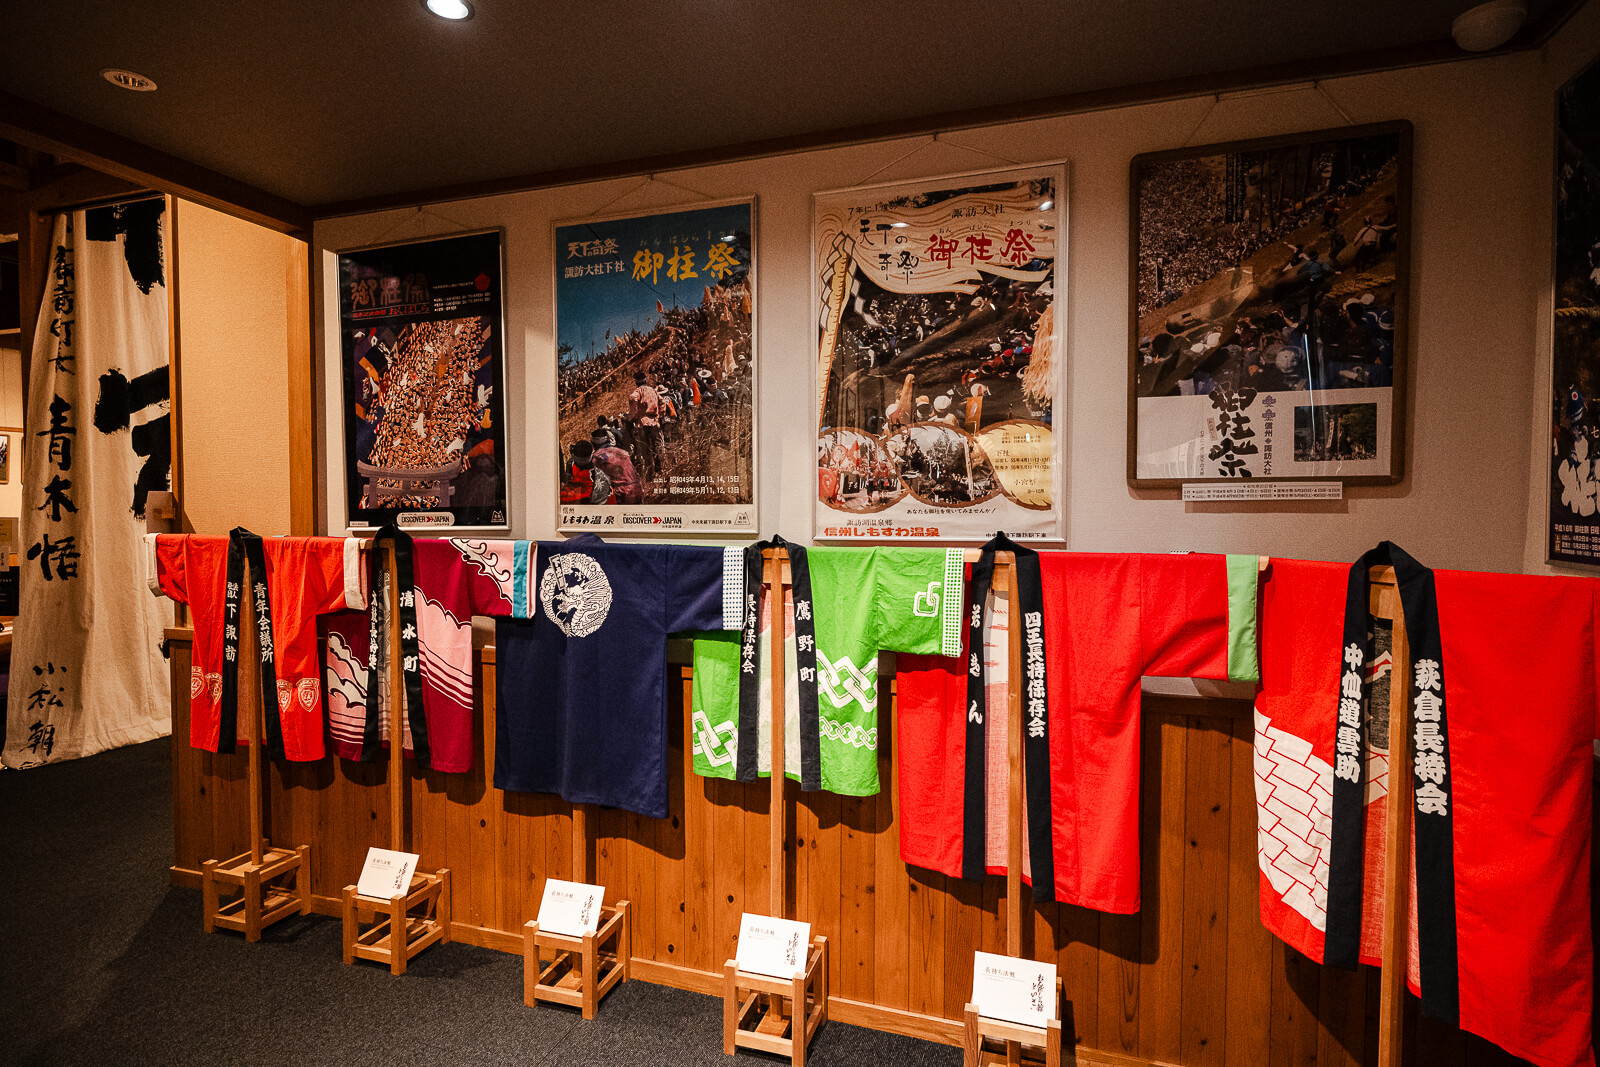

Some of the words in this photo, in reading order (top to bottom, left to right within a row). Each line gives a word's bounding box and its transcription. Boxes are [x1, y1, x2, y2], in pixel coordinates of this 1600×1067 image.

[951, 204, 1006, 219] 諏訪大社
[567, 238, 620, 260] 天下の奇祭
[632, 242, 741, 285] 御柱祭
[877, 251, 919, 285] 奇祭
[924, 228, 1036, 270] 御柱祭
[564, 260, 626, 279] 諏訪大社下社
[1208, 381, 1259, 478] 御柱祭
[1263, 444, 1274, 476] 諏訪大社
[27, 393, 81, 582] 青木悟
[401, 515, 426, 523] DISCOVER
[433, 515, 450, 523] JAPAN
[562, 516, 615, 525] しもすわ温泉
[622, 517, 653, 525] DISCOVER
[662, 517, 682, 525] JAPAN
[824, 527, 940, 537] 信州しもすわ温泉
[253, 582, 274, 664] 青年会議所
[399, 591, 418, 673] 清水町
[795, 600, 816, 683] 鷹野町
[1024, 611, 1047, 738] 四王長持保存会
[1413, 659, 1448, 817] 萩倉長持会
